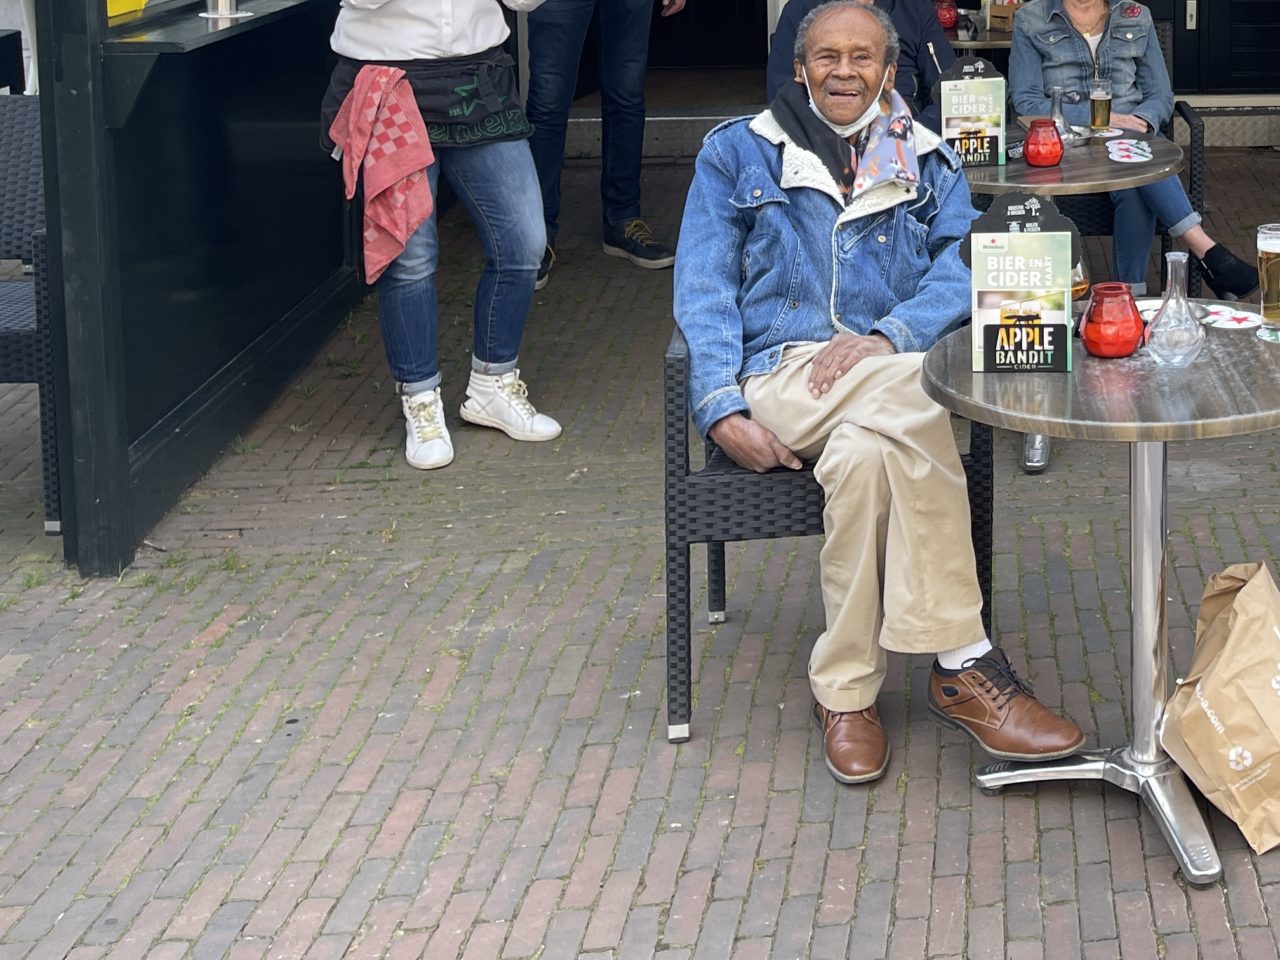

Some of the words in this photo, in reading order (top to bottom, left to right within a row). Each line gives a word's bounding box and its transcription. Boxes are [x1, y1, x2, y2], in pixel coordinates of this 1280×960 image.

[953, 138, 991, 154] APPLE
[959, 153, 991, 163] ANDIT
[987, 256, 1026, 270] BIER
[1029, 258, 1042, 268] EN
[1044, 256, 1053, 286] KAART
[987, 271, 1042, 287] CIDER
[996, 327, 1054, 351] APPLE
[995, 351, 1054, 364] BANDIT
